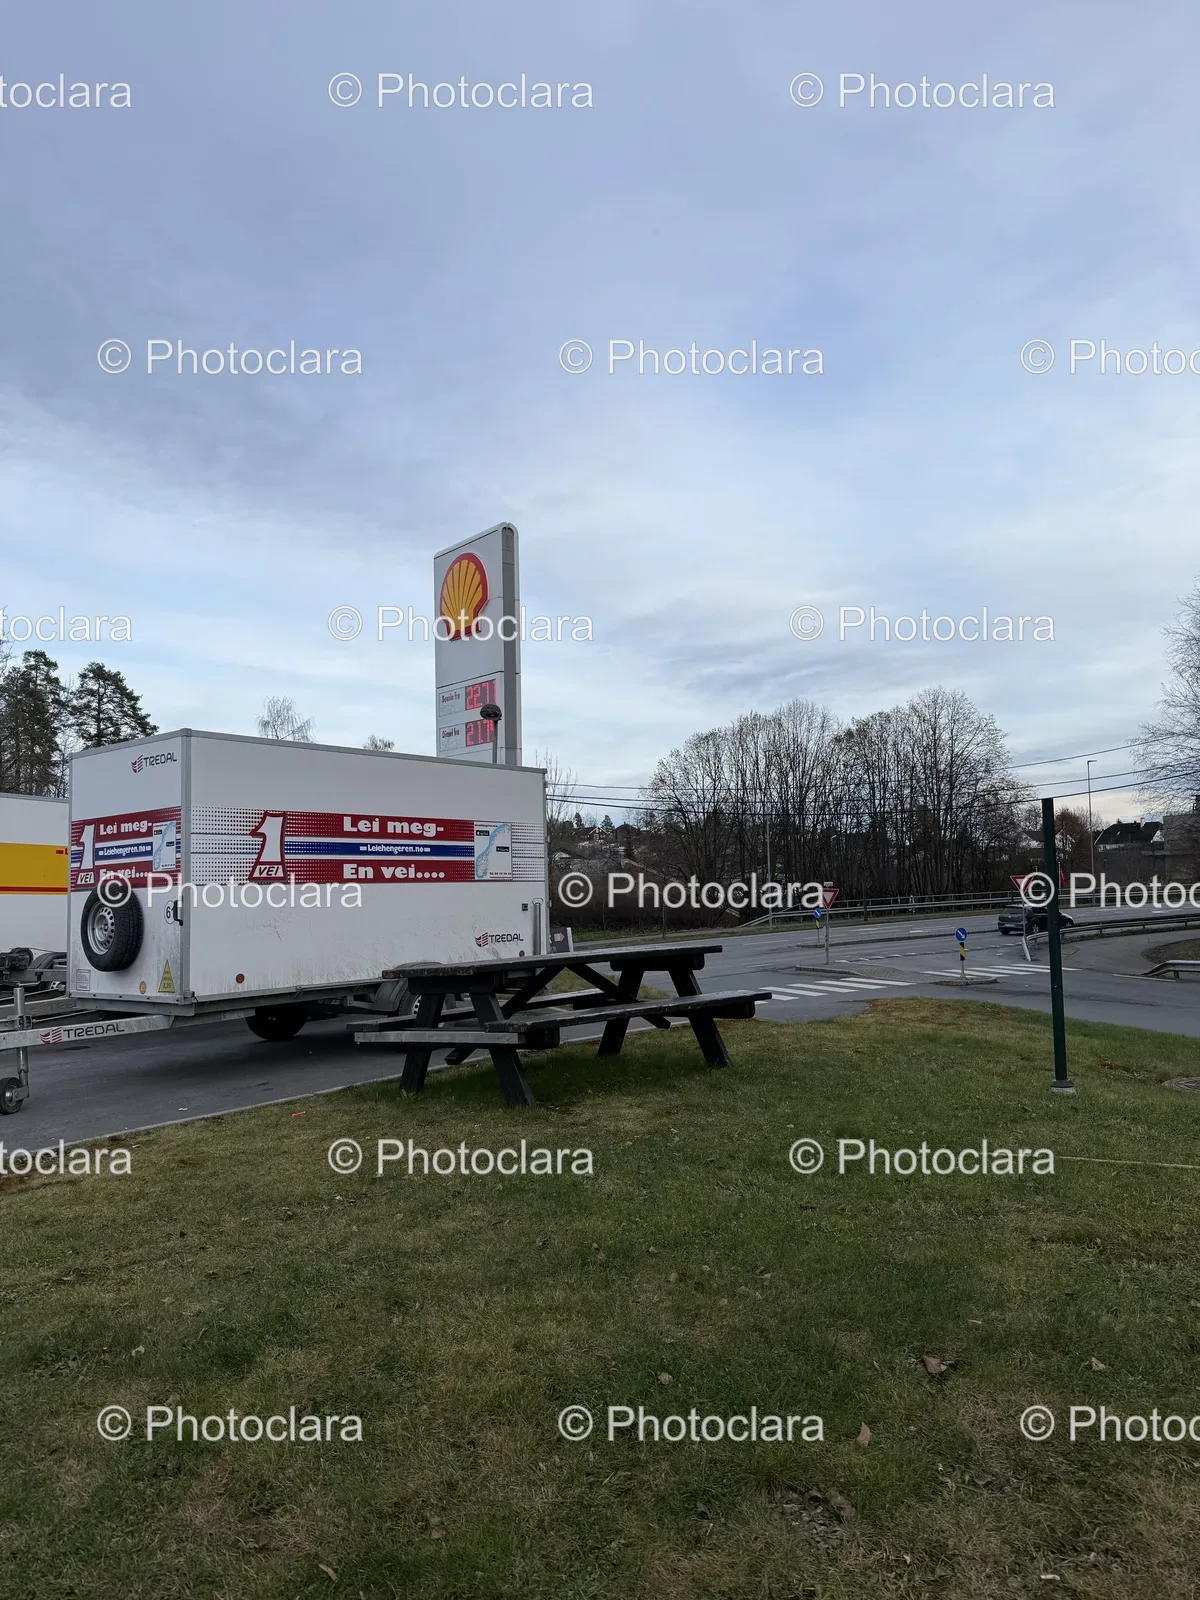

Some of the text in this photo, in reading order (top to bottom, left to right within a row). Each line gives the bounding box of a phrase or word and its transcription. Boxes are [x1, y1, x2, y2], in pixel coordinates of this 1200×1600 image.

[441, 728, 453, 739] Diesel
[144, 752, 178, 767] TREDAL
[99, 819, 153, 836] Lei meg-
[343, 816, 445, 838] Lei meg-
[254, 814, 285, 863] 1
[78, 823, 95, 870] 1
[104, 845, 146, 857] Leiehengeren.no
[367, 844, 424, 854] Leiehengeren.no
[79, 872, 93, 884] VEI
[99, 868, 114, 881] En
[258, 866, 280, 876] VEI
[343, 863, 374, 879] En
[489, 931, 525, 944] TREDAL
[63, 1022, 125, 1039] TREDAL
